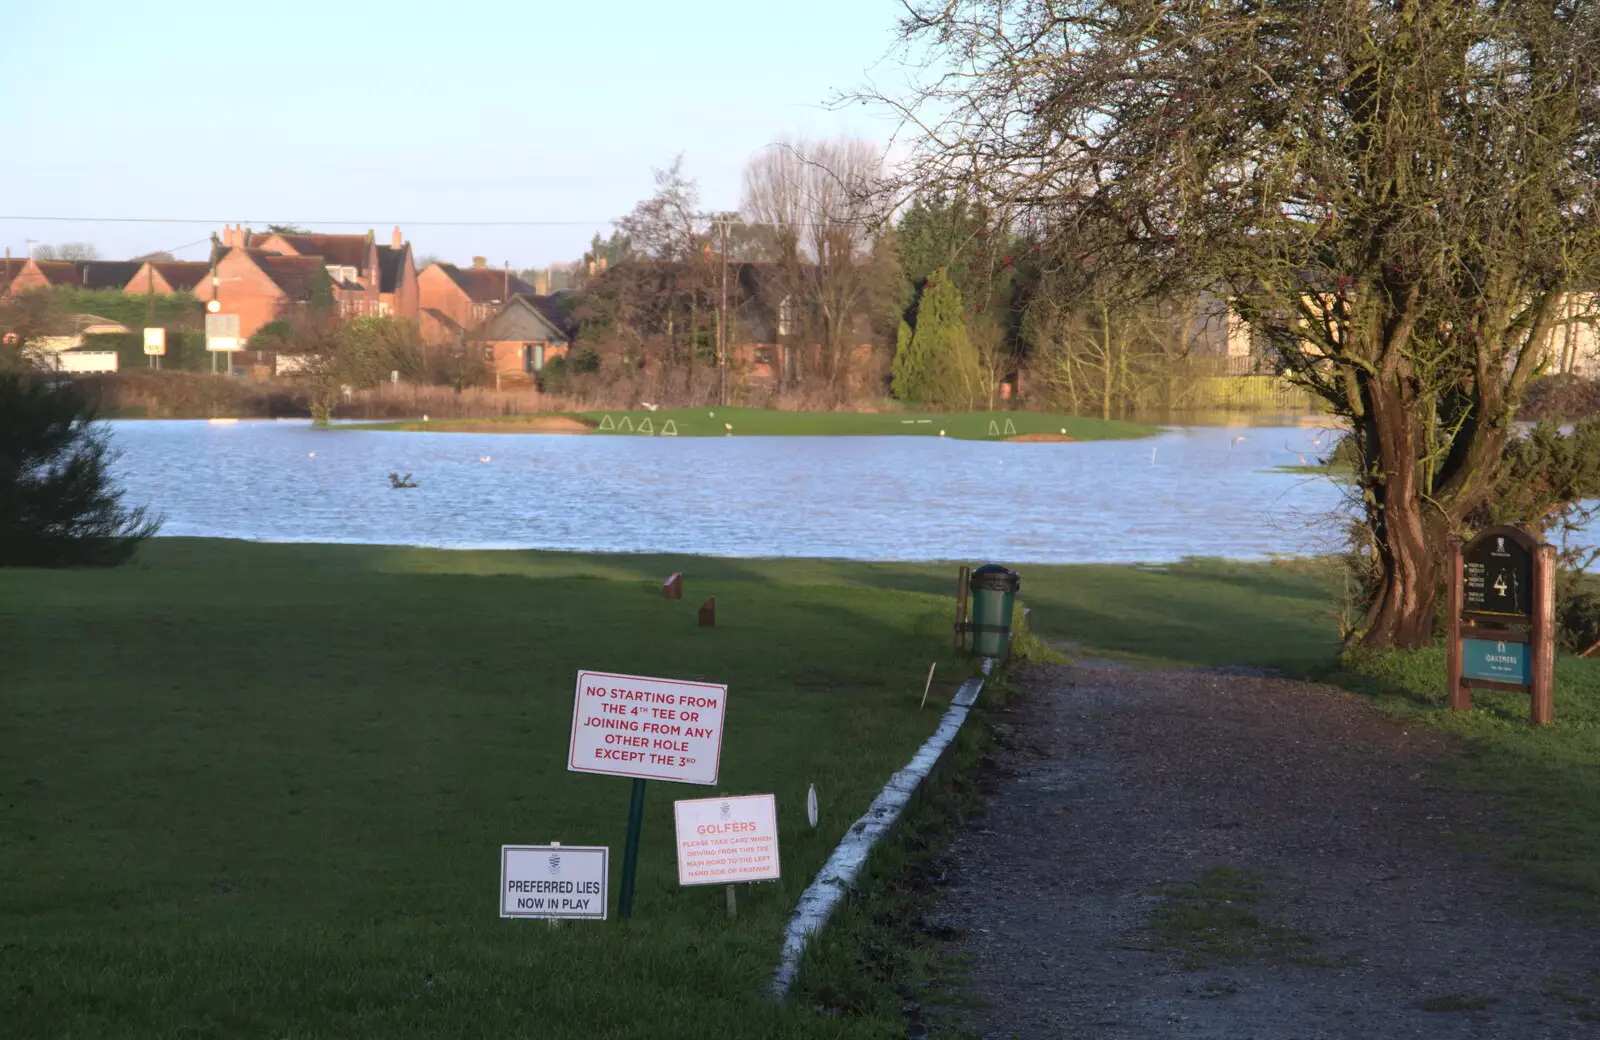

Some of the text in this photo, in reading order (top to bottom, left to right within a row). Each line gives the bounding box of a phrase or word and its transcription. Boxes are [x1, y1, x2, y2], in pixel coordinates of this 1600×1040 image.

[1493, 574, 1508, 597] 4
[586, 686, 717, 709] NO STARTING FROM
[601, 703, 626, 715] THE
[652, 708, 676, 720] TEE
[680, 711, 699, 722] OR
[583, 716, 713, 739] JOINING FROM ANY
[605, 734, 689, 751] OTHER HOLE
[595, 748, 645, 763] EXCEPT
[649, 753, 674, 766] THE
[697, 821, 757, 835] GOLFERS
[739, 865, 770, 873] FAIRWAY
[508, 880, 600, 894] PREFERRED LIES
[517, 898, 590, 910] NOW IN PLAY
